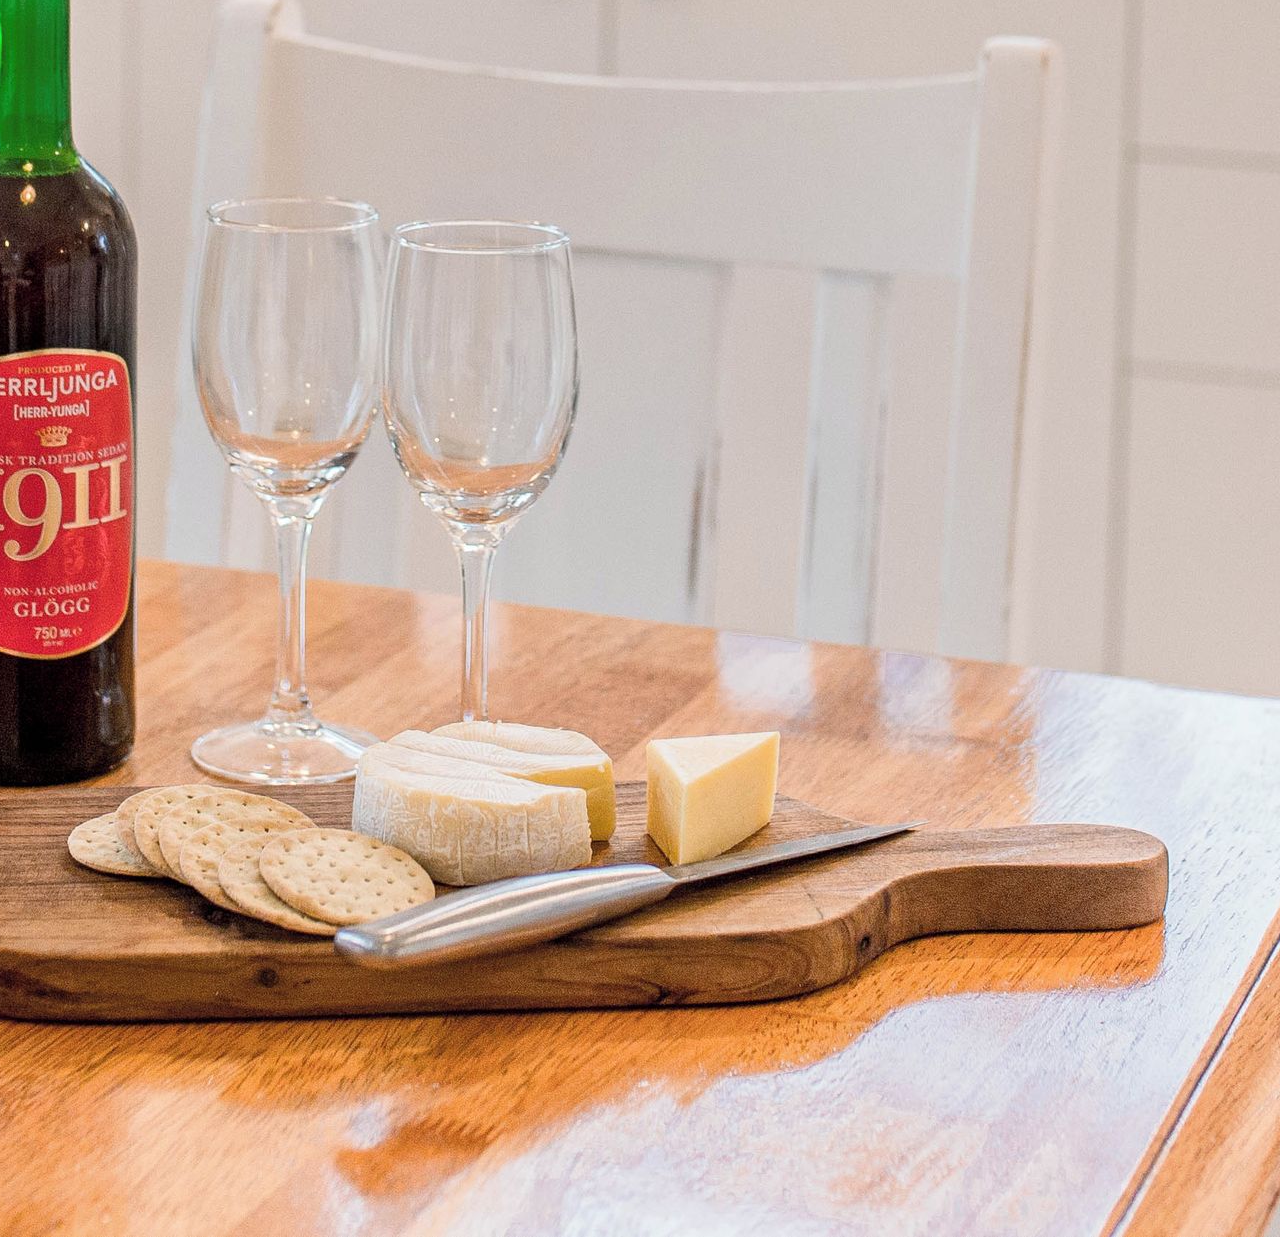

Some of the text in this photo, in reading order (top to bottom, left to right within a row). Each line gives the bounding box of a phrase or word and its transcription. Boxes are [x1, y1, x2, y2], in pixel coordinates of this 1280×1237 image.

[18, 362, 88, 374] PRODUCED BY
[19, 451, 95, 466] TRADITION
[97, 443, 128, 459] SEDAN
[13, 597, 90, 617] GLÖGG
[34, 626, 58, 640] 750
